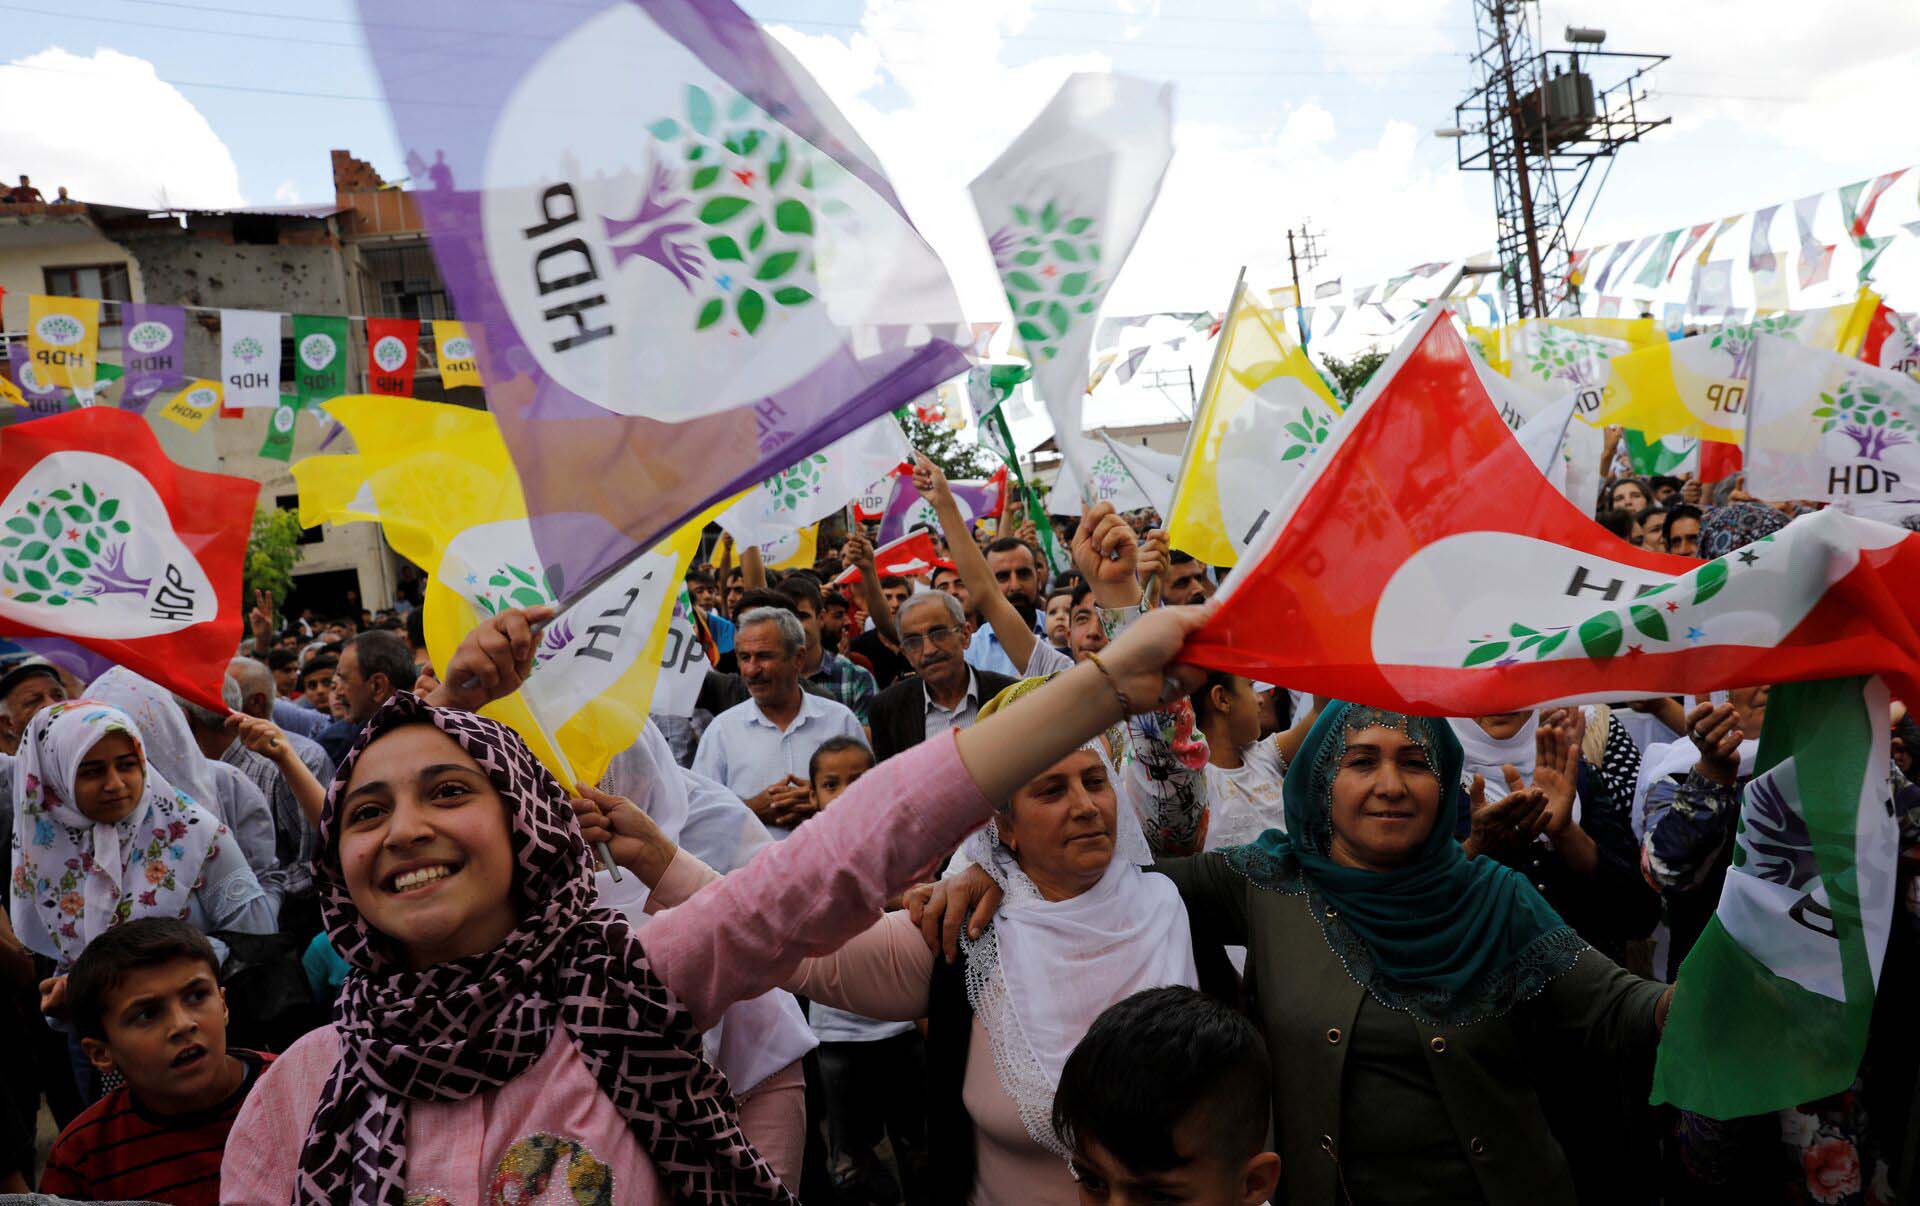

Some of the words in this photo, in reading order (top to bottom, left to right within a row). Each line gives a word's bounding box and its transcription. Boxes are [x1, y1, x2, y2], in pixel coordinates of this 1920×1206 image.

[171, 403, 204, 420] HDP
[1828, 464, 1901, 495] HDP
[150, 563, 195, 621] HDP
[661, 627, 705, 674] DP
